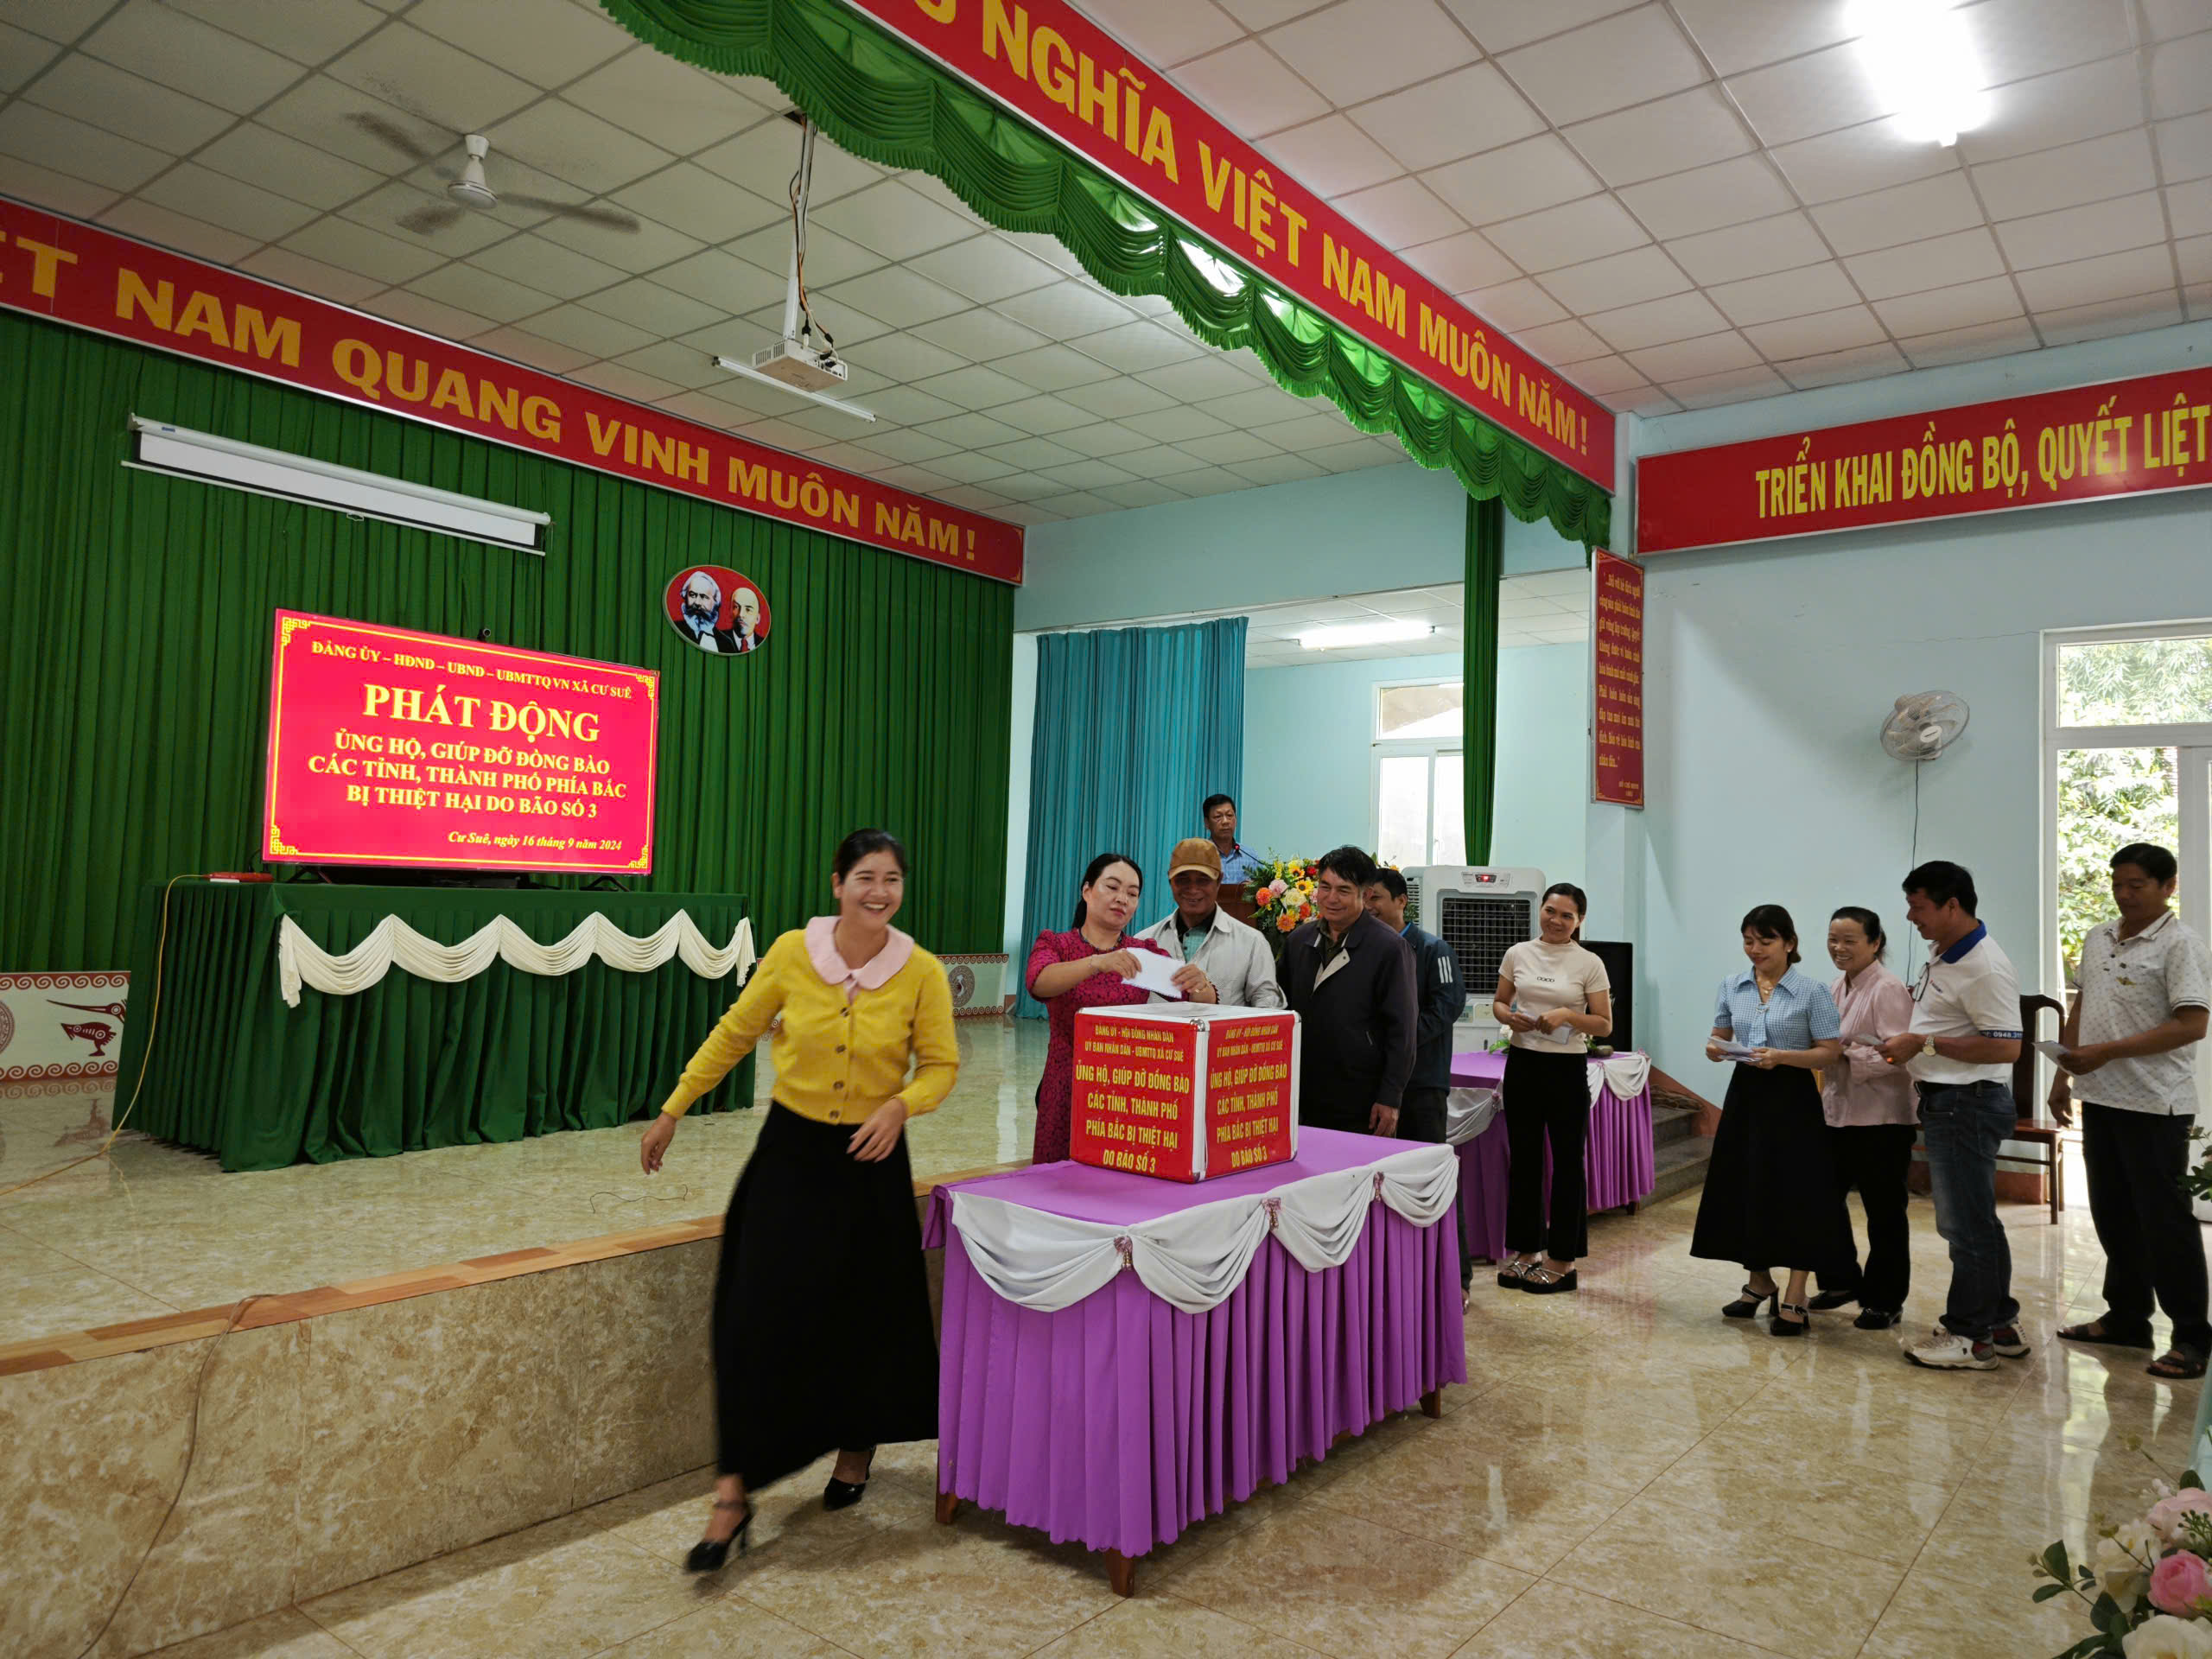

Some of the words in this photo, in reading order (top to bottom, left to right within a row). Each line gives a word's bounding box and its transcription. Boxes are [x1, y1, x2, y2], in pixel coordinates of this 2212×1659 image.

[982, 0, 1179, 185] NGHĨA
[1198, 139, 1307, 268] VIỆT
[1323, 232, 1406, 339] NAM
[1420, 302, 1510, 409] MUÔN
[116, 267, 302, 368] NAM
[332, 338, 561, 443] QUANG
[585, 411, 709, 486] VINH
[728, 456, 860, 529] MUÔN
[1755, 436, 1826, 518] TRIỂN
[1834, 451, 1892, 509] KHAI
[1901, 421, 1974, 500] ĐỒNG
[1982, 417, 2029, 499] BỘ,
[2037, 395, 2133, 492] QUYẾT
[2143, 392, 2211, 478] LIỆT
[312, 639, 356, 658] ĐẢNG
[394, 653, 435, 670] HĐND
[448, 662, 485, 677] UBND
[497, 669, 551, 689] UBMTTQ
[553, 677, 570, 690] VN
[591, 683, 608, 696] CƯ
[610, 686, 632, 698] SUÊ
[363, 683, 480, 728] PHÁT
[489, 701, 600, 743] ĐỘNG
[335, 728, 384, 753] ỦNG
[389, 737, 426, 760] HỘ,
[430, 741, 480, 761] GIÚP
[484, 746, 512, 765] ĐỠ
[516, 748, 569, 771] ĐỒNG
[574, 754, 610, 774] BÀO
[308, 753, 358, 775] CÁC
[363, 757, 422, 784] TỈNH,
[426, 764, 497, 787] THÀNH
[502, 772, 542, 791] PHỐ
[545, 775, 588, 795] PHÍA
[592, 779, 627, 798] BẮC
[346, 785, 370, 807] BỊ
[374, 788, 441, 810] THIỆT
[445, 791, 481, 813] HẠI
[486, 795, 515, 812] DO
[519, 796, 558, 816] BÃO
[562, 798, 585, 817] SỐ
[588, 804, 597, 817] 3
[448, 831, 467, 843] Cư
[467, 832, 492, 846] Suê,
[494, 834, 520, 848] ngày
[523, 835, 534, 846] 16
[537, 836, 566, 850] tháng
[567, 837, 575, 848] 9
[576, 838, 597, 849] năm
[599, 840, 622, 851] 2024
[1112, 1065, 1133, 1086] GIÚP
[1234, 1065, 1249, 1085] GIÚP
[1088, 1090, 1105, 1109] CÁC
[1160, 1098, 1179, 1121] PHỐ
[1217, 1096, 1230, 1116] CÁC
[1086, 1117, 1105, 1137] PHÍA
[1108, 1117, 1125, 1140] BẮC
[1127, 1125, 1136, 1146] BỊ
[1138, 1125, 1161, 1149] THIỆT
[1163, 1130, 1178, 1152] HẠI
[1217, 1122, 1231, 1144] PHÍA
[1245, 1121, 1251, 1141] BỊ
[1252, 1116, 1268, 1138] THIỆT
[1103, 1149, 1115, 1166] DO
[1135, 1150, 1149, 1172] SỐ
[1150, 1157, 1156, 1173] 3
[1231, 1150, 1240, 1168] DO
[1262, 1146, 1268, 1161] 3
